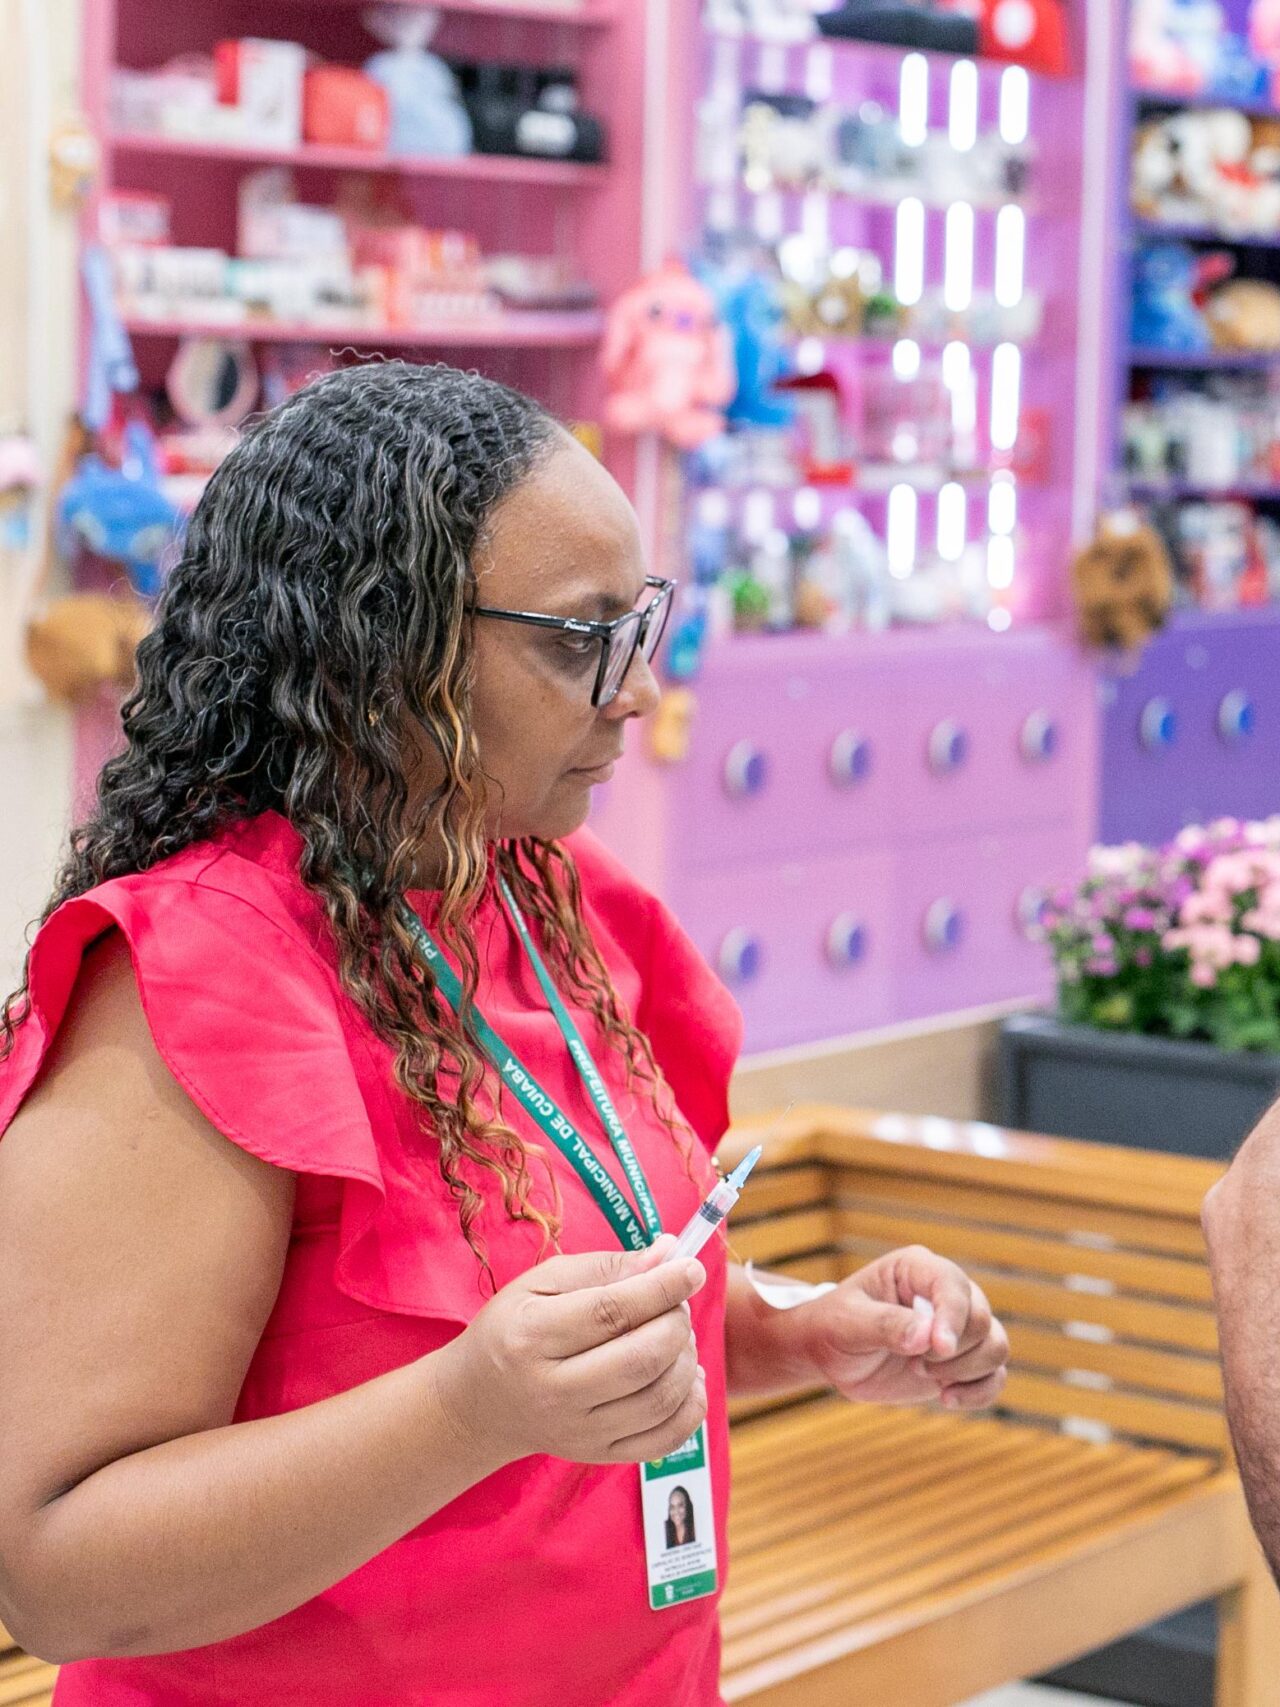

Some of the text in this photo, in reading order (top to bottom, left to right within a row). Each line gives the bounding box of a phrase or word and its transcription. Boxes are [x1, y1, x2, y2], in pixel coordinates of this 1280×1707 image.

[502, 1057, 647, 1251] URA MUNICIPAL DE CUIABÁ
[569, 1040, 658, 1229] PREFEITURA MUNICIPAL
